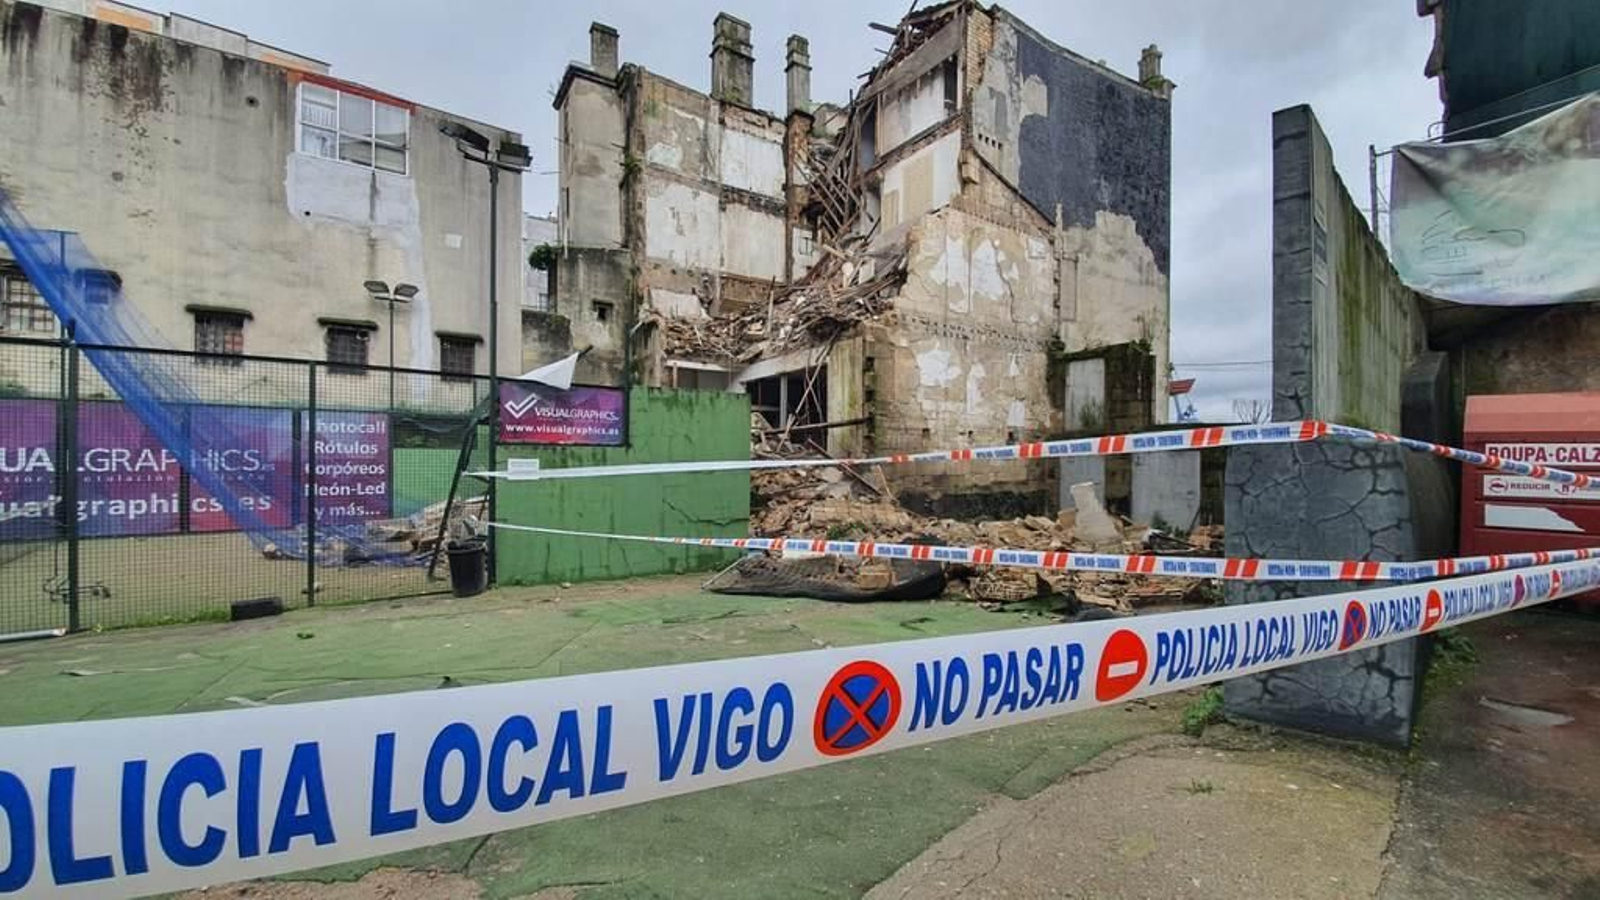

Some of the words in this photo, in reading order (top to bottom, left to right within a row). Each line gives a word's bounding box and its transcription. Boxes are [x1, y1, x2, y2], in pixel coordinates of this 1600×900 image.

[314, 440, 378, 455] Rótulos
[370, 704, 627, 836] LOCAL
[654, 682, 794, 782] VIGO
[908, 656, 969, 732] NO
[975, 643, 1084, 719] PASAR
[1150, 623, 1238, 686] POLICIA
[1239, 615, 1296, 668] LOCAL
[1300, 609, 1338, 654] VIGO
[1368, 602, 1387, 639] NO
[1387, 596, 1421, 634] PASAR
